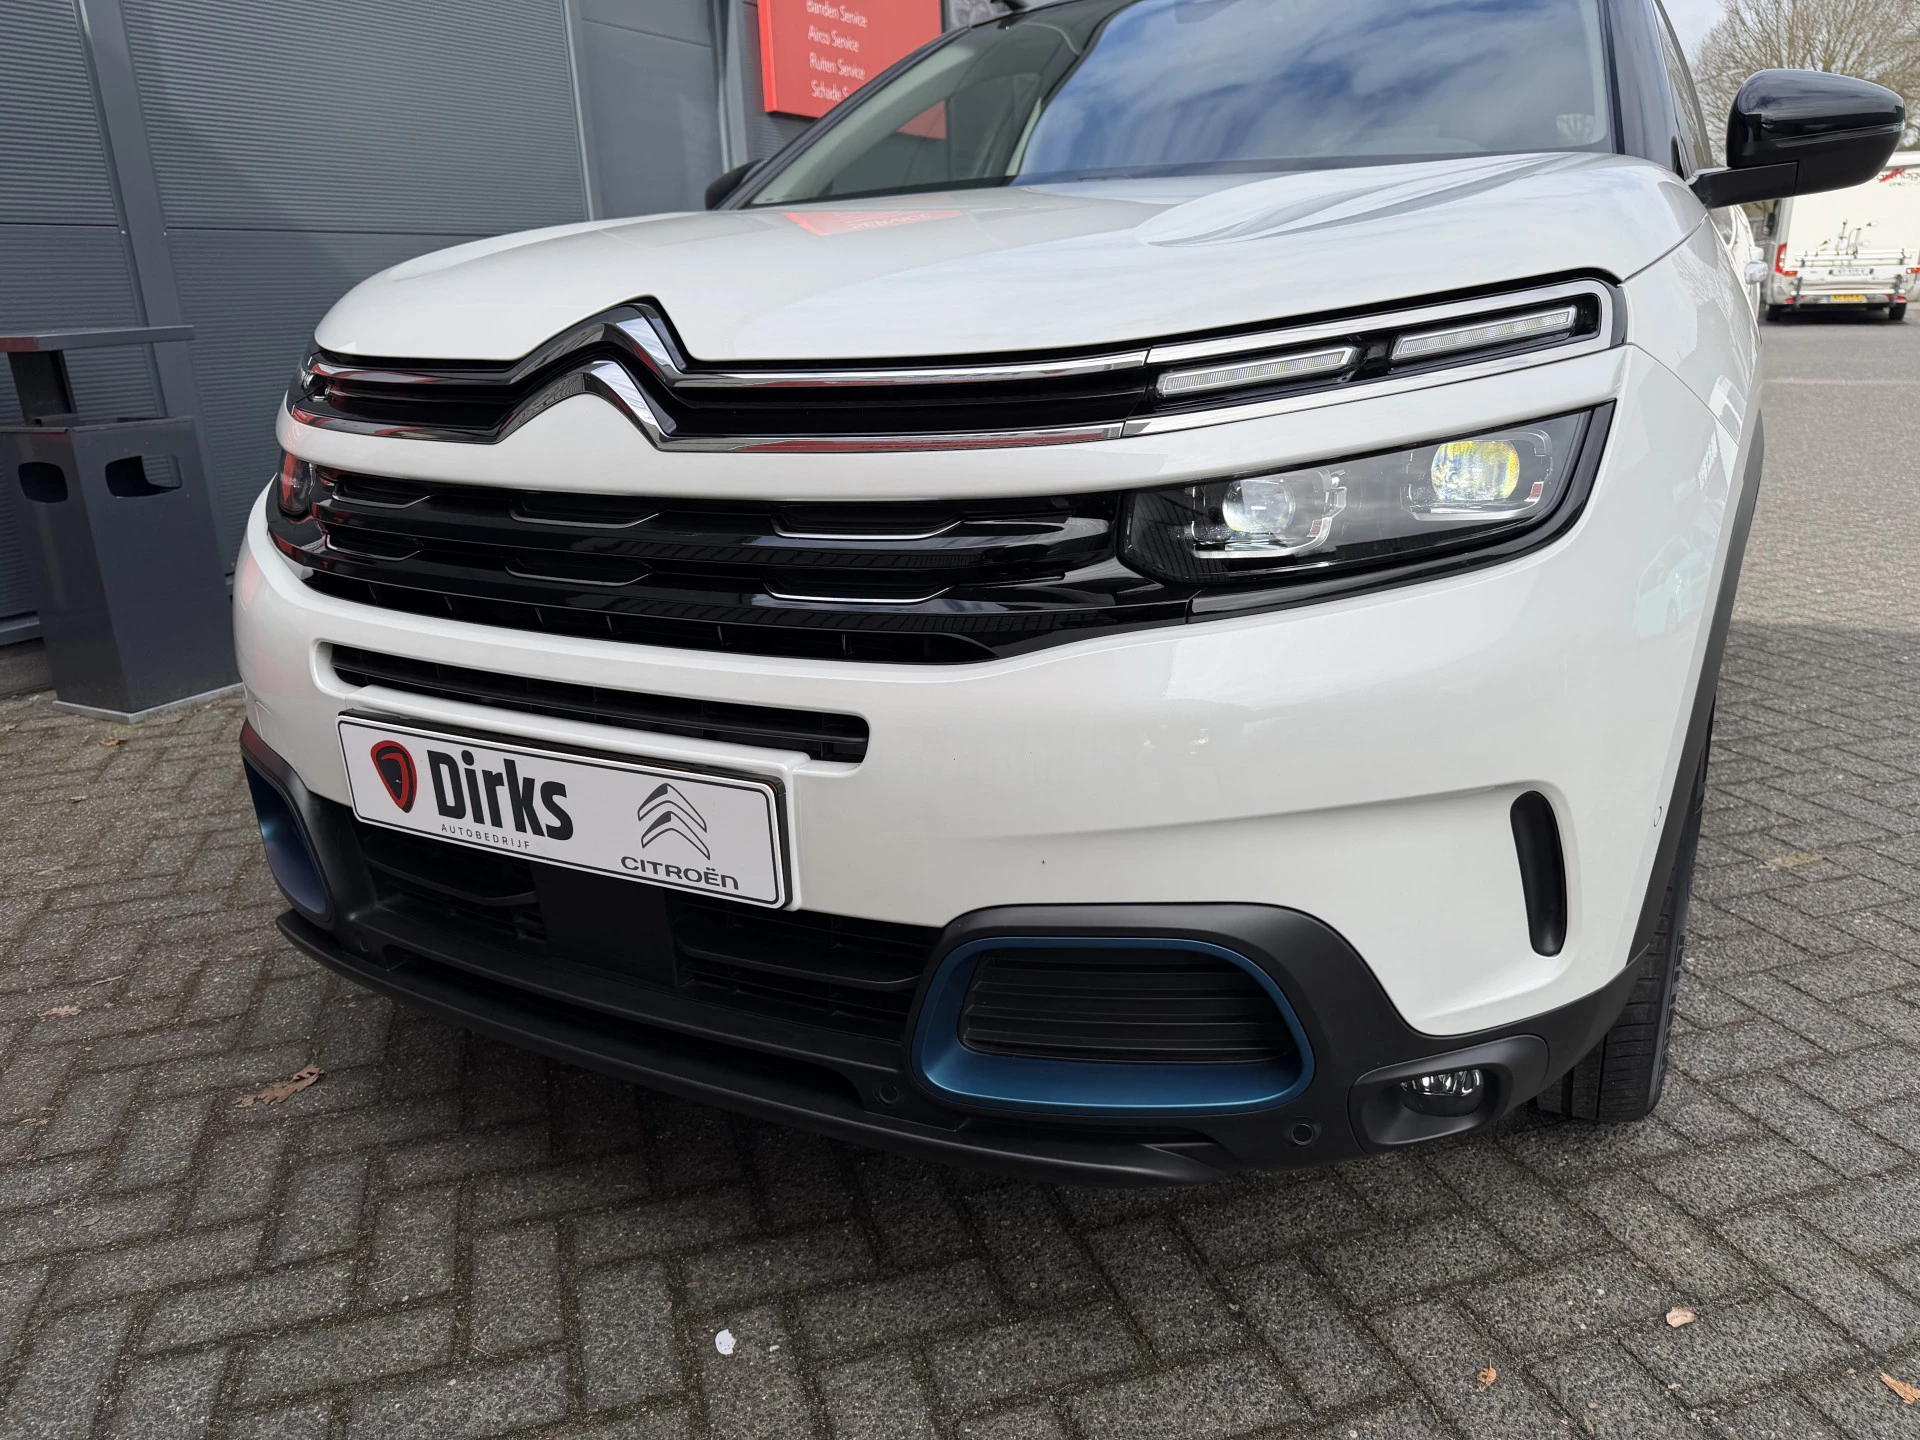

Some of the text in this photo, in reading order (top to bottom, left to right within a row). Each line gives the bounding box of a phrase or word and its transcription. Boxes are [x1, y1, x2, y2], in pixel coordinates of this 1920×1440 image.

[807, 0, 867, 28] Banden Service
[808, 24, 860, 52] Airco Service
[810, 52, 865, 80] Ruiten Service
[811, 80, 841, 102] Schade
[427, 750, 574, 841] Dirks
[441, 823, 530, 849] AUTOBEDRIJF
